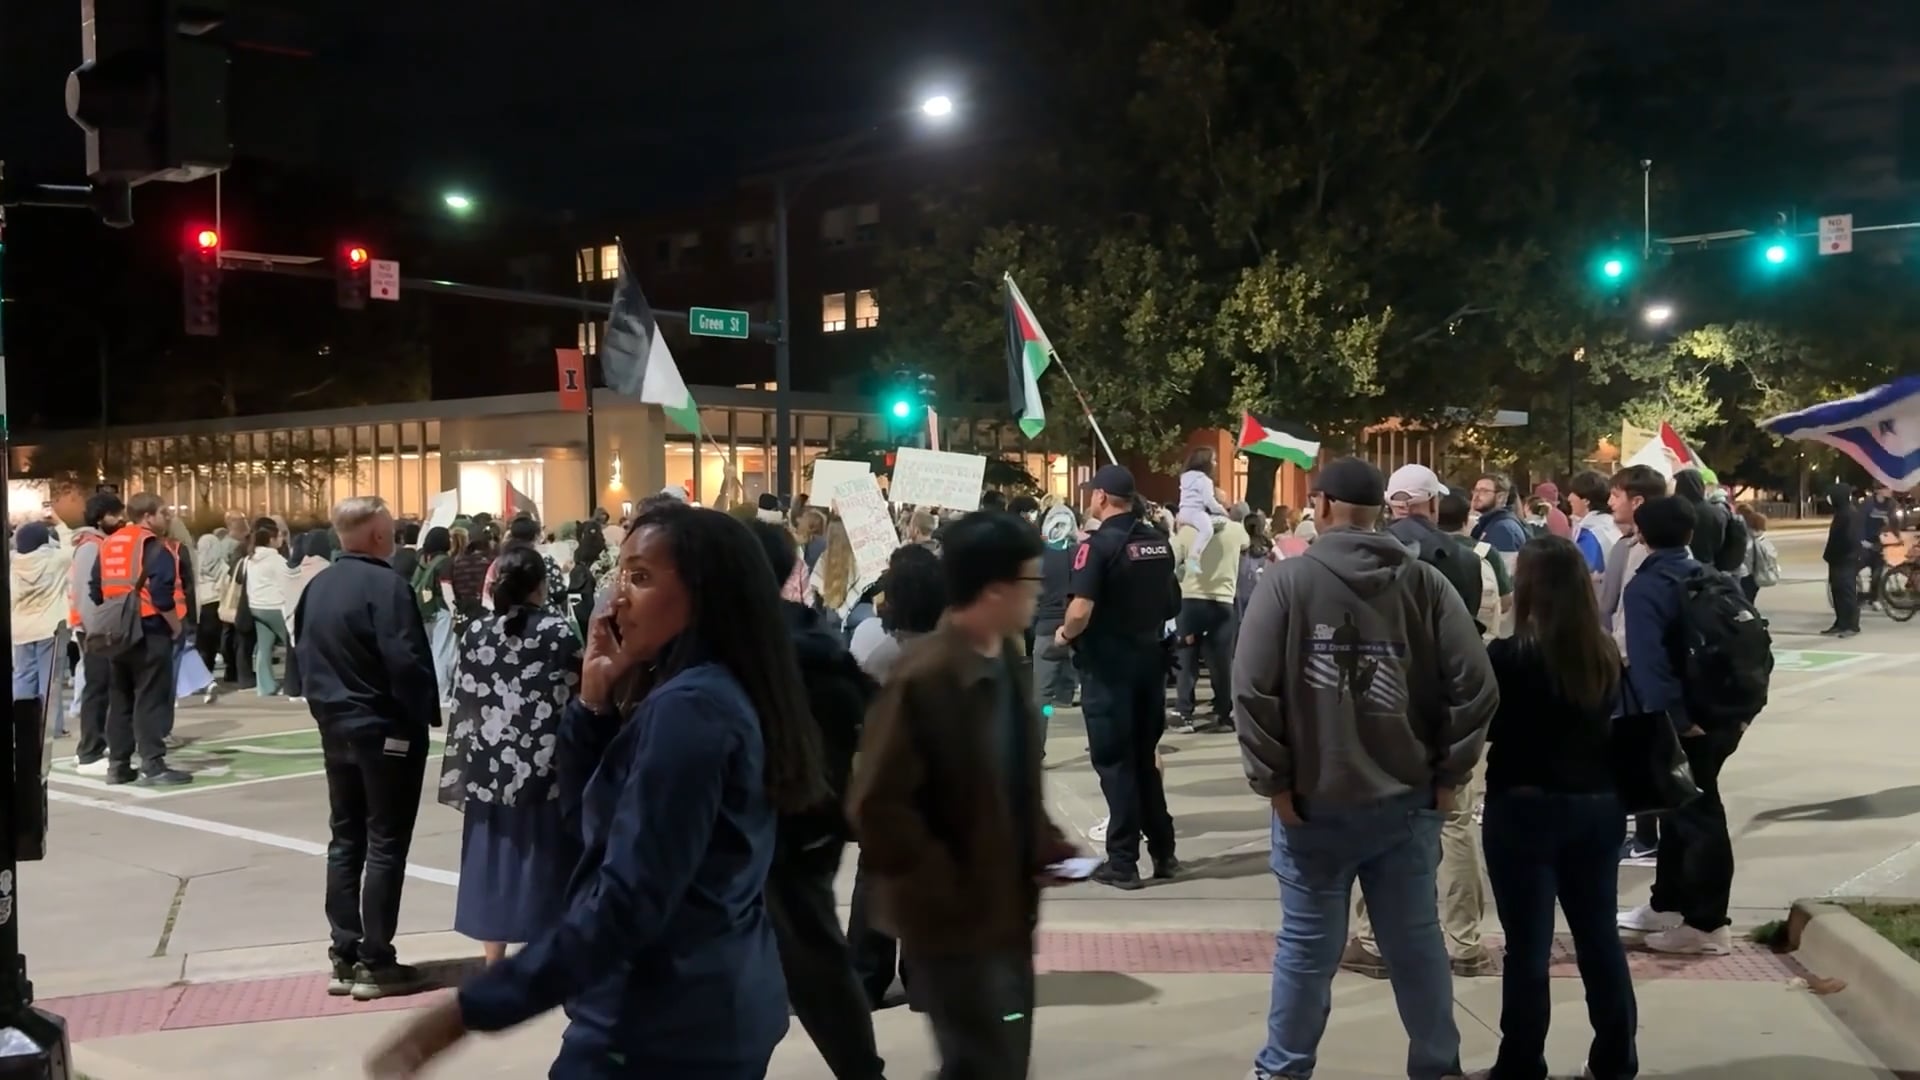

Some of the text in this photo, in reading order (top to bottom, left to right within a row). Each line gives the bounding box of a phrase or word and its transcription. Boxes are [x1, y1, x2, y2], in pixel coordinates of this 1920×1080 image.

[1828, 219, 1842, 227] NO
[699, 314, 740, 332] Green St
[565, 369, 578, 391] I
[1140, 546, 1167, 556] POLICE
